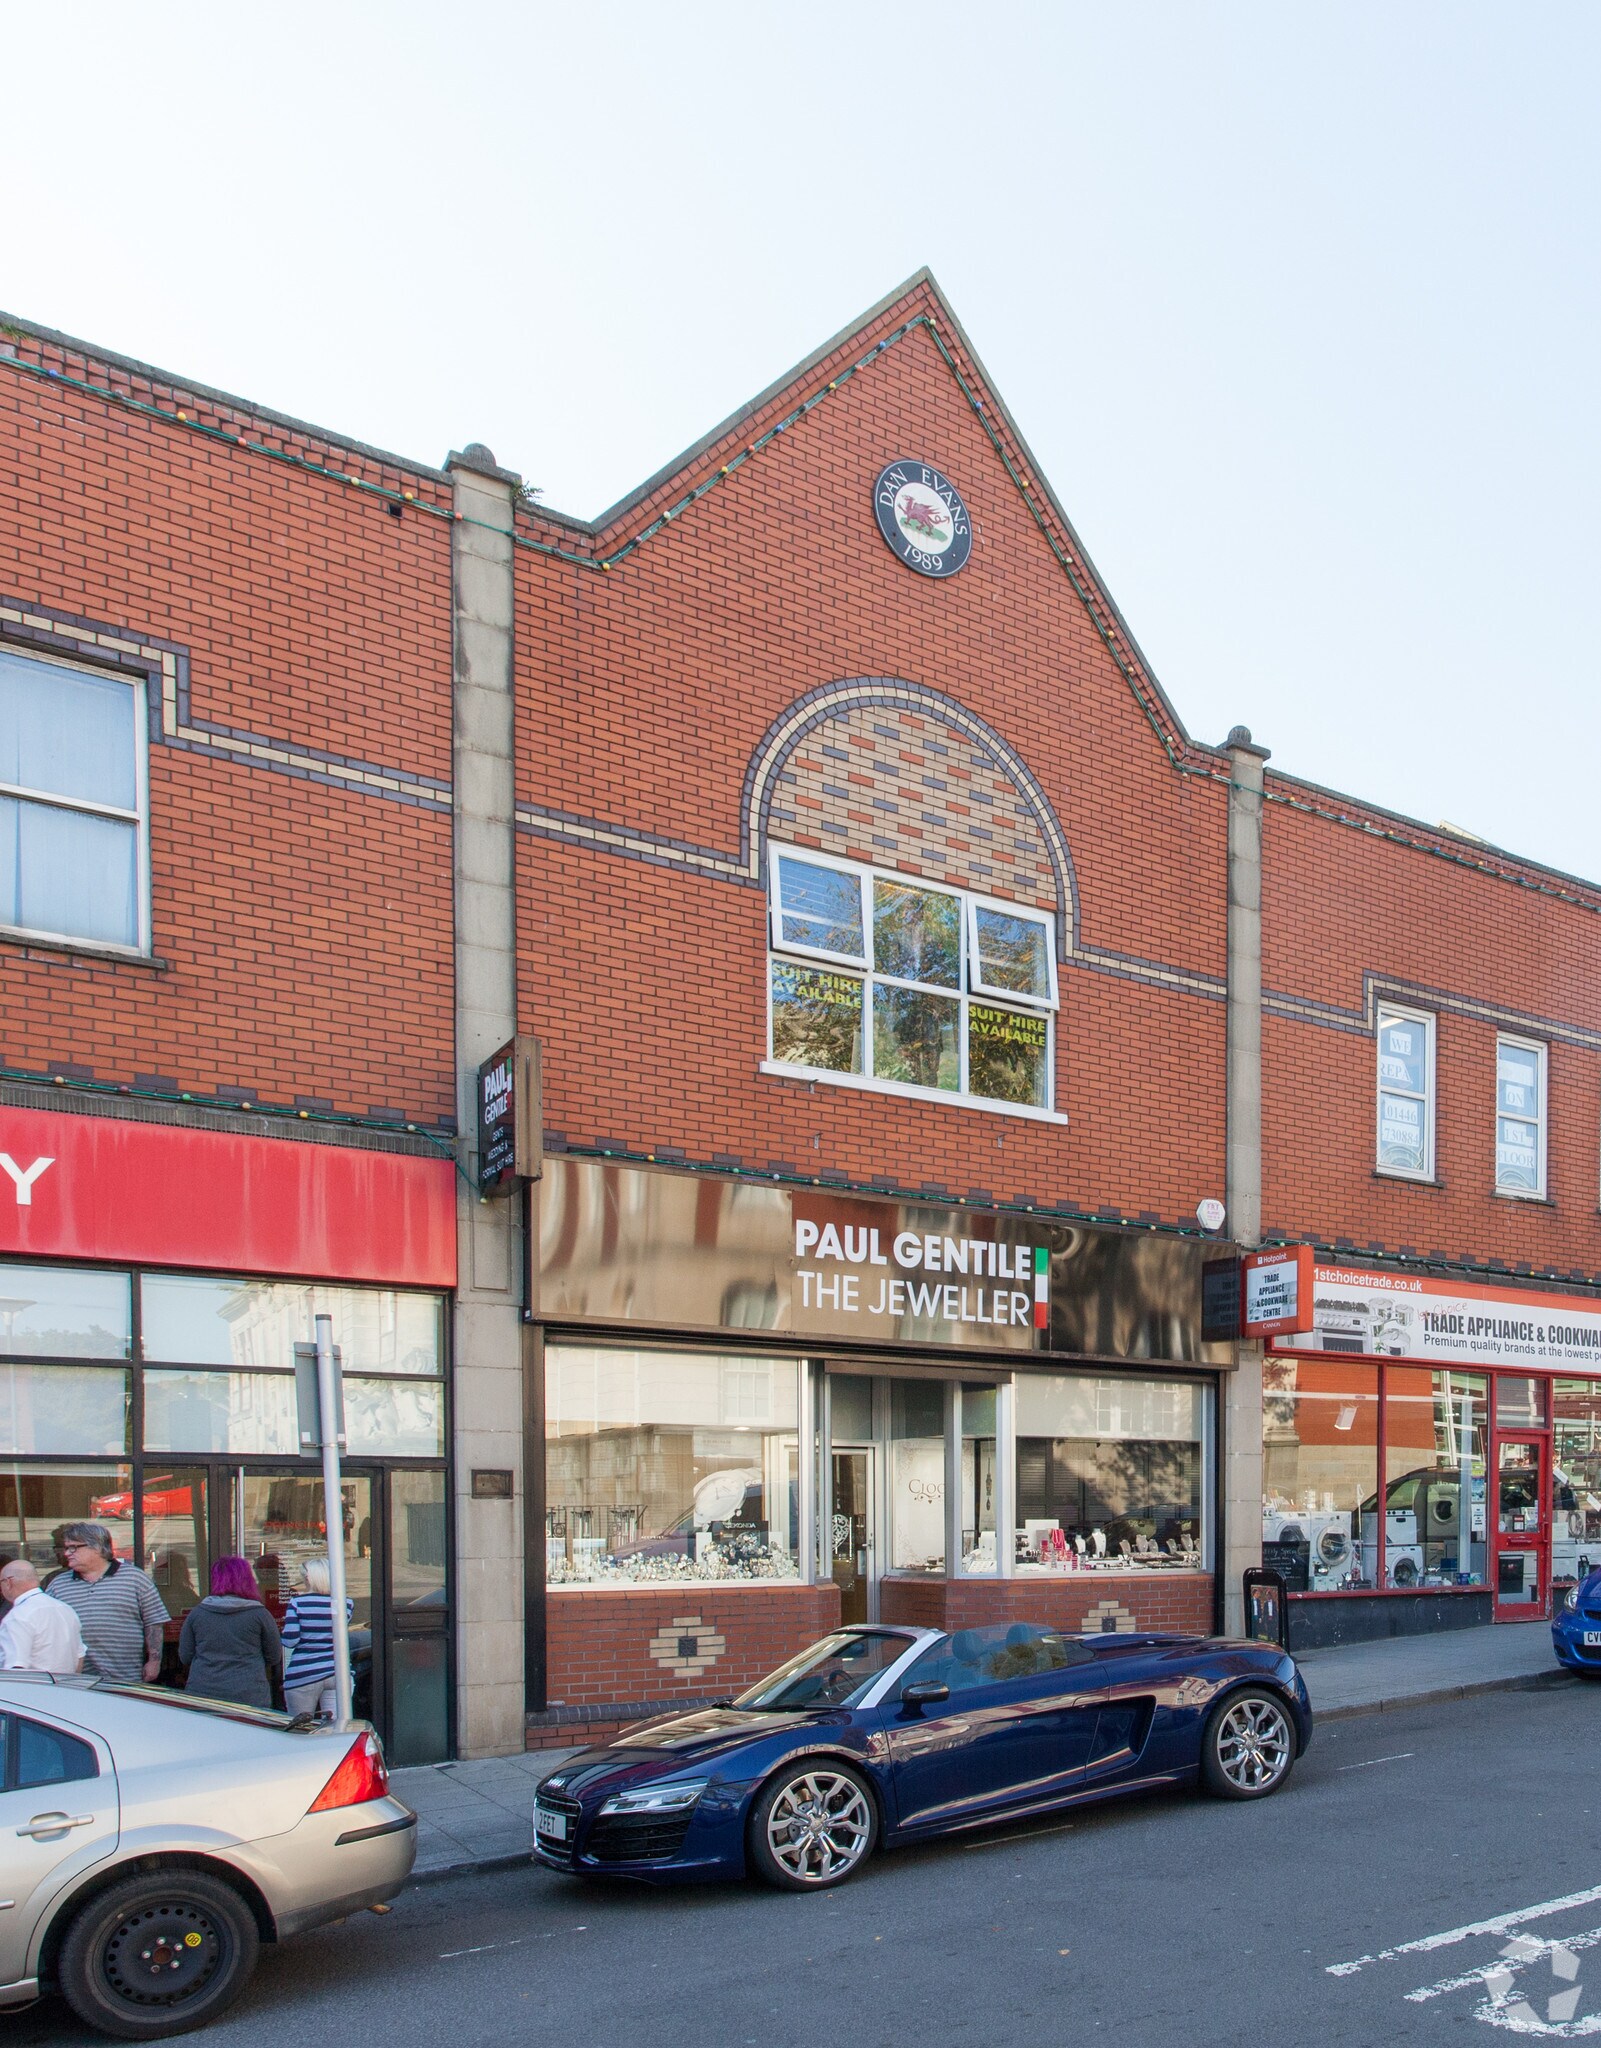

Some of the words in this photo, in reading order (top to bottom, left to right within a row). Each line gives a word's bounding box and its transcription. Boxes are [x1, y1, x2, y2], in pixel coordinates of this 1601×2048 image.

[880, 468, 908, 508] DAN
[921, 468, 968, 536] EVANS
[903, 544, 943, 571] 1989
[772, 964, 813, 983] SUIT
[820, 974, 861, 994] HIRE
[772, 980, 861, 1008] AVAILABLE
[969, 1005, 1006, 1023] SUIT
[1010, 1015, 1045, 1033] HIRE
[970, 1020, 1045, 1047] AVAILABLE
[1391, 1037, 1411, 1053] WE
[485, 1063, 507, 1103] PAUL
[485, 1093, 507, 1124] GENTILE
[1387, 1105, 1417, 1123] 01446
[795, 1219, 888, 1266] PAUL
[893, 1232, 1031, 1281] GENTILE
[1263, 1252, 1287, 1264] Hotpoint
[1259, 1283, 1285, 1296] APPLIANCE
[1264, 1273, 1280, 1283] TRADE
[1313, 1268, 1422, 1292] 1stchoicetrade.co.uk
[797, 1271, 859, 1312] THE
[868, 1278, 1030, 1327] JEWELLER
[1261, 1294, 1288, 1307] COOKWARE
[1263, 1307, 1281, 1318] CENTRE
[1423, 1312, 1464, 1334] TRADE
[1467, 1316, 1534, 1342] APPLIANCE
[1537, 1326, 1545, 1342] &
[1424, 1334, 1467, 1348] Premium
[1470, 1340, 1501, 1354] quality
[1504, 1341, 1535, 1355] brands
[1538, 1345, 1546, 1355] at
[1548, 1344, 1562, 1357] the
[1564, 1346, 1592, 1360] lowest
[1587, 1632, 1601, 1643] CV
